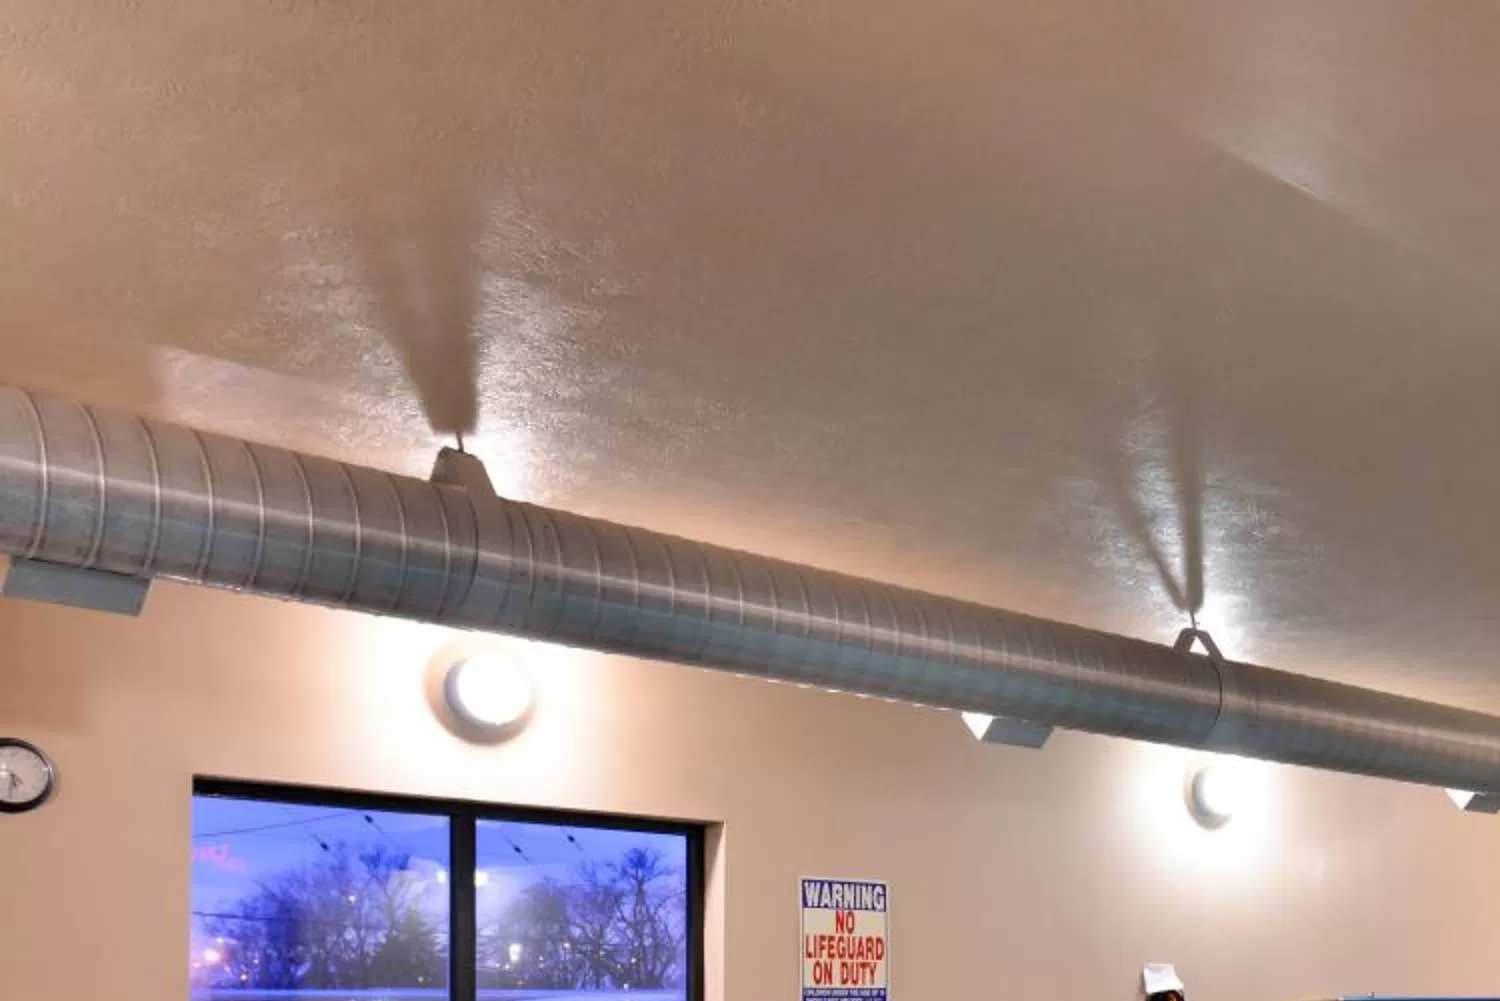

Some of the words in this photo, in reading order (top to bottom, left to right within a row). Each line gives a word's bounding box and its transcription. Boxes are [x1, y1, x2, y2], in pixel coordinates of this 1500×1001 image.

[804, 881, 884, 910] WARNING
[836, 910, 855, 934] NO
[806, 935, 884, 961] LIFEGUARD
[813, 961, 833, 985] ON
[840, 962, 877, 985] DUTY
